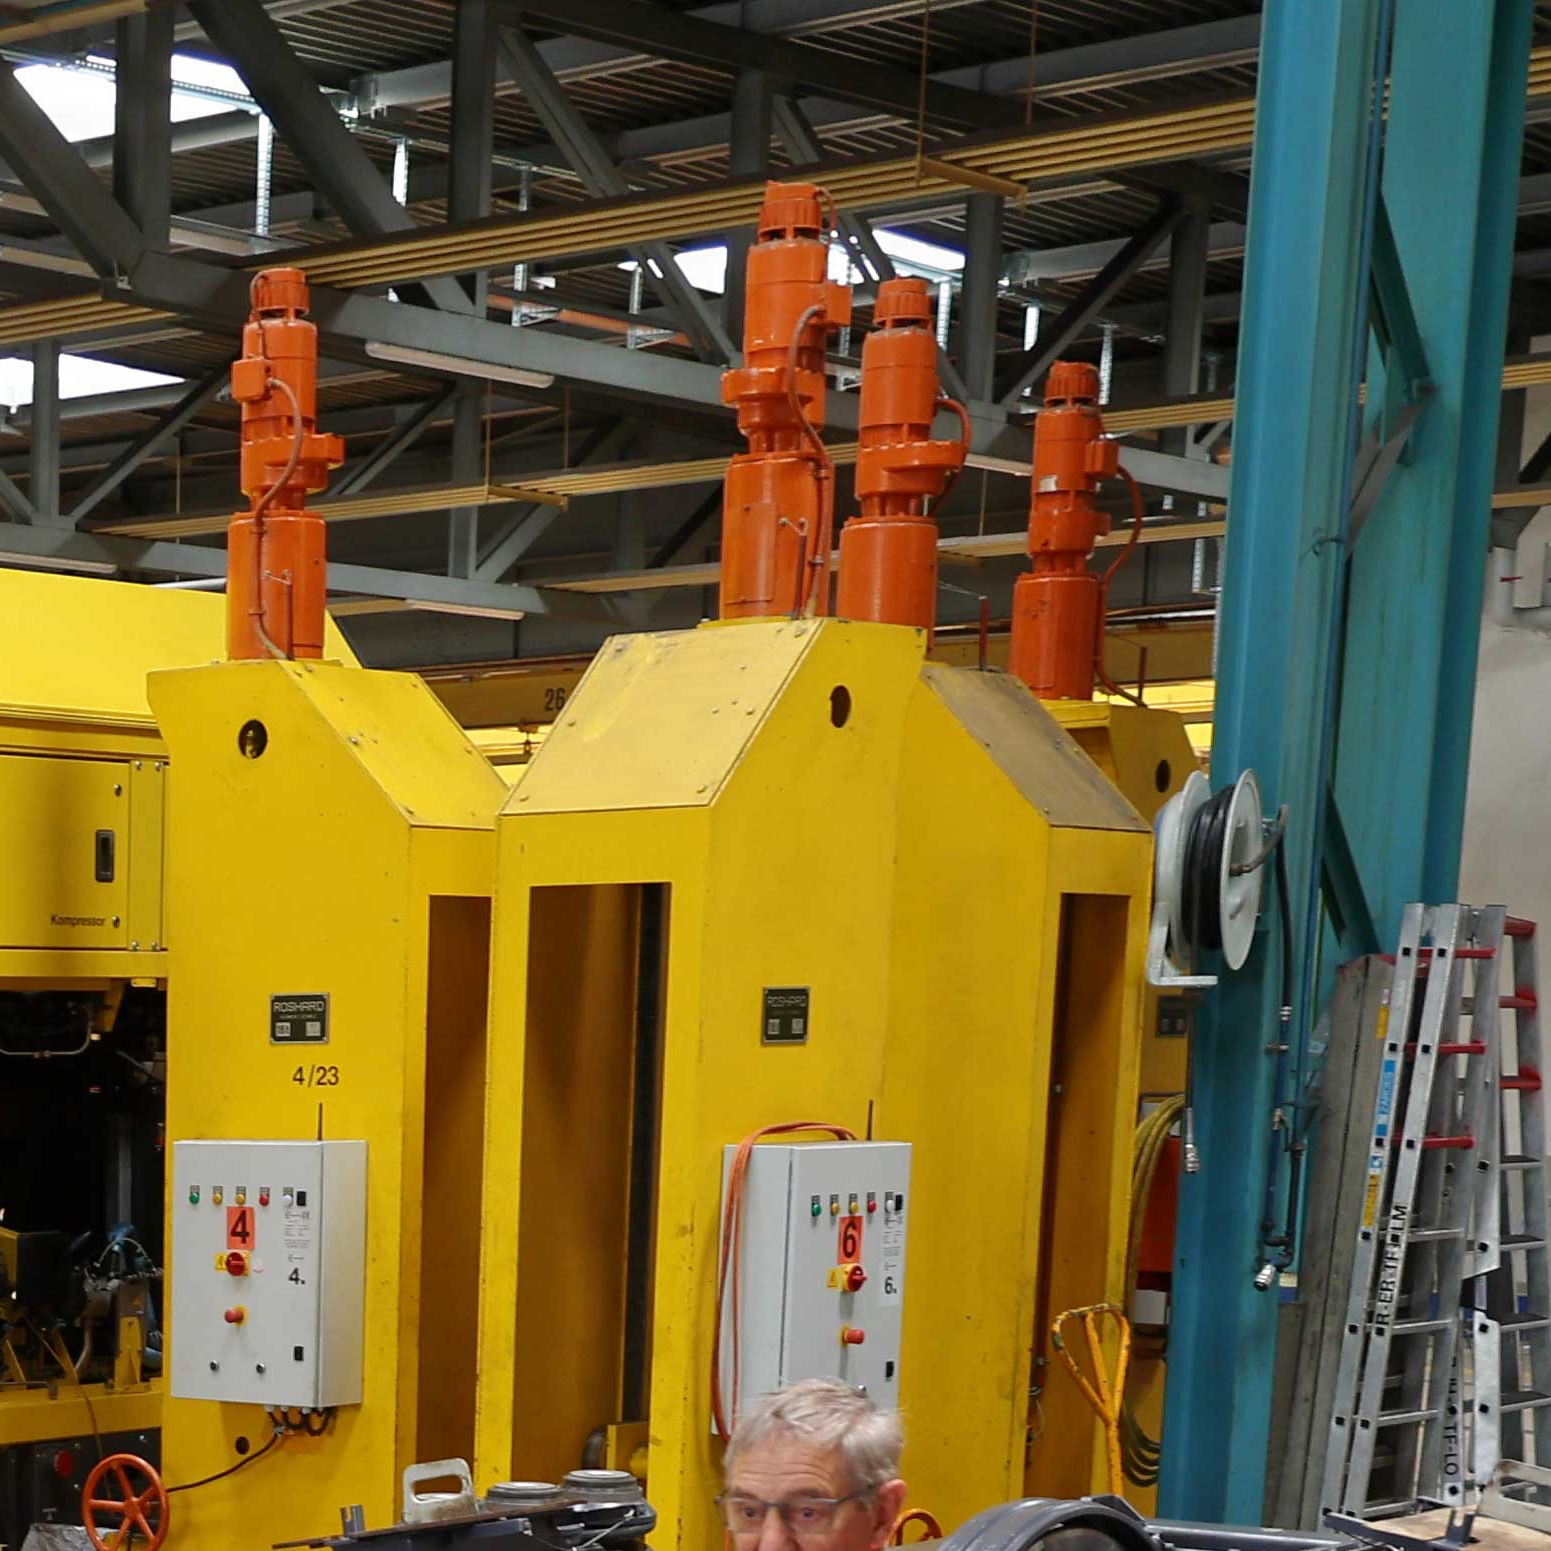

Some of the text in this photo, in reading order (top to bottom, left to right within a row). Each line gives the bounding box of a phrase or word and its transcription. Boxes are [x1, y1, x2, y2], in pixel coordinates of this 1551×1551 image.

[544, 688, 566, 711] 26
[50, 913, 107, 928] Kompressor
[292, 1064, 340, 1088] 4/23
[230, 1209, 250, 1244] 4
[842, 1219, 858, 1259] 6
